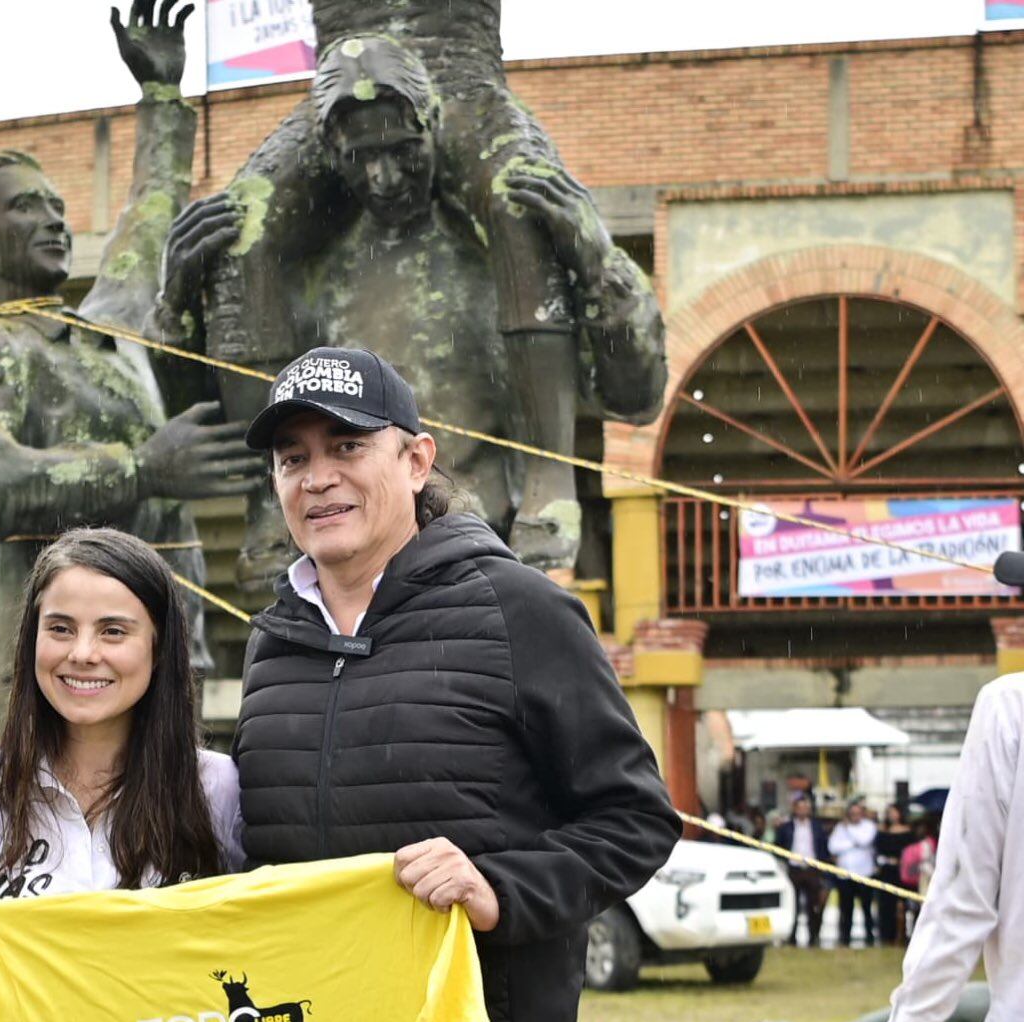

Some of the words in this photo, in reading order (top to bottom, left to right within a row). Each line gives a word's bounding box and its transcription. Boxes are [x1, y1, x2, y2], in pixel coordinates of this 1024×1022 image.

[301, 357, 350, 370] QUIERO
[938, 517, 960, 534] LA
[965, 512, 1001, 530] VIDA
[754, 562, 784, 583] POR
[862, 551, 884, 569] DE
